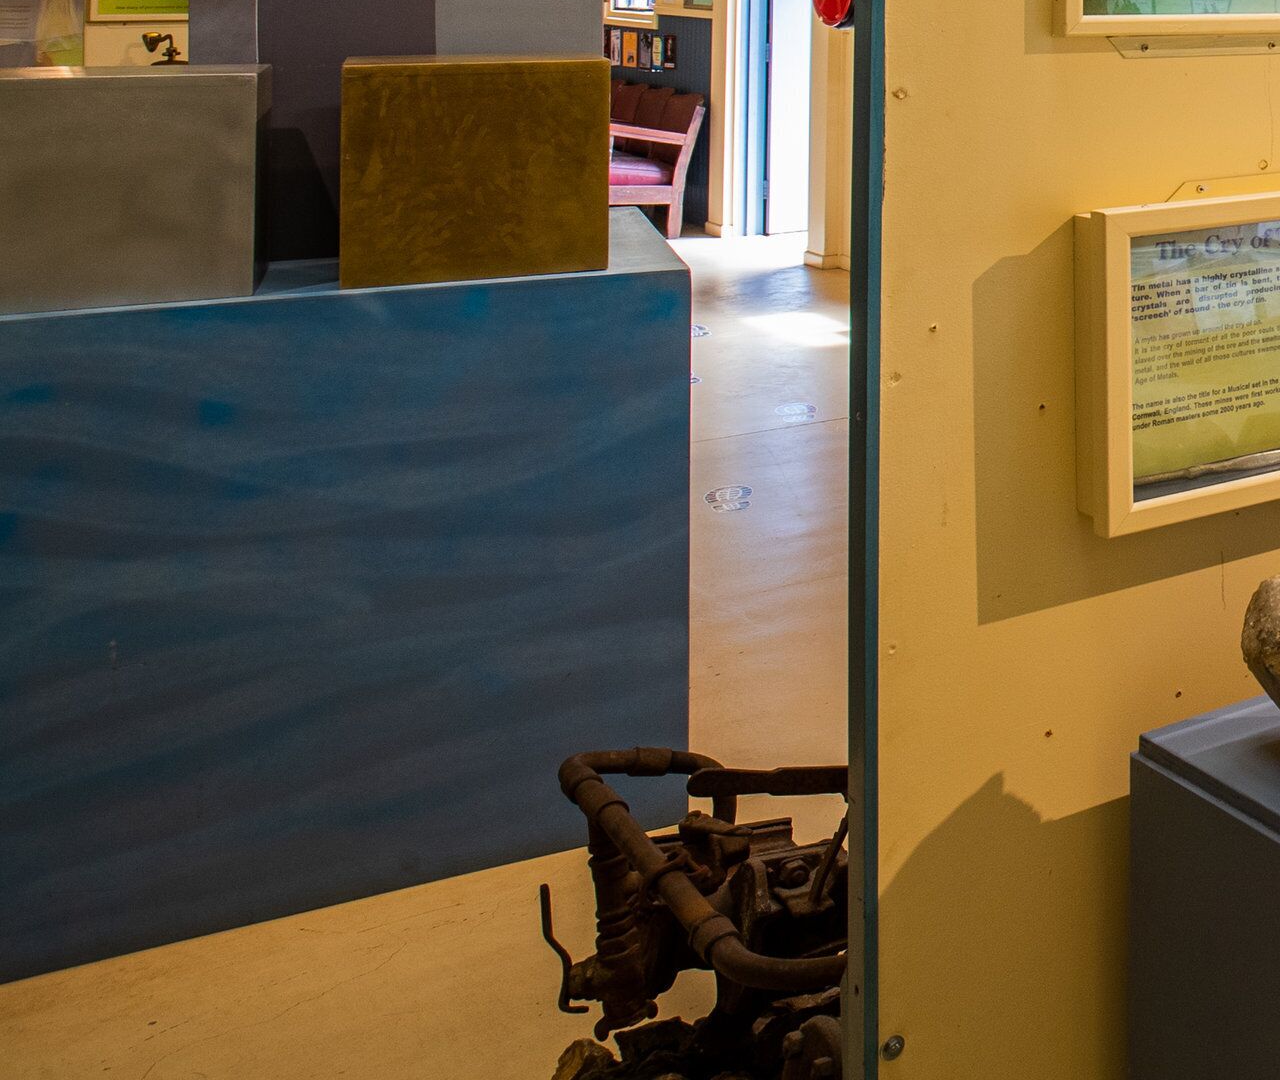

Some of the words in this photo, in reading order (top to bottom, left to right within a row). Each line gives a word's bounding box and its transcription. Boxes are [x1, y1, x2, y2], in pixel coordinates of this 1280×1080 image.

[1155, 239, 1196, 262] The
[1205, 235, 1243, 256] Cry
[1250, 227, 1274, 249] of
[1131, 283, 1145, 292] Tin
[1148, 278, 1172, 290] metal
[1176, 277, 1190, 286] has
[1202, 271, 1228, 283] highly
[1229, 265, 1272, 280] crystalline
